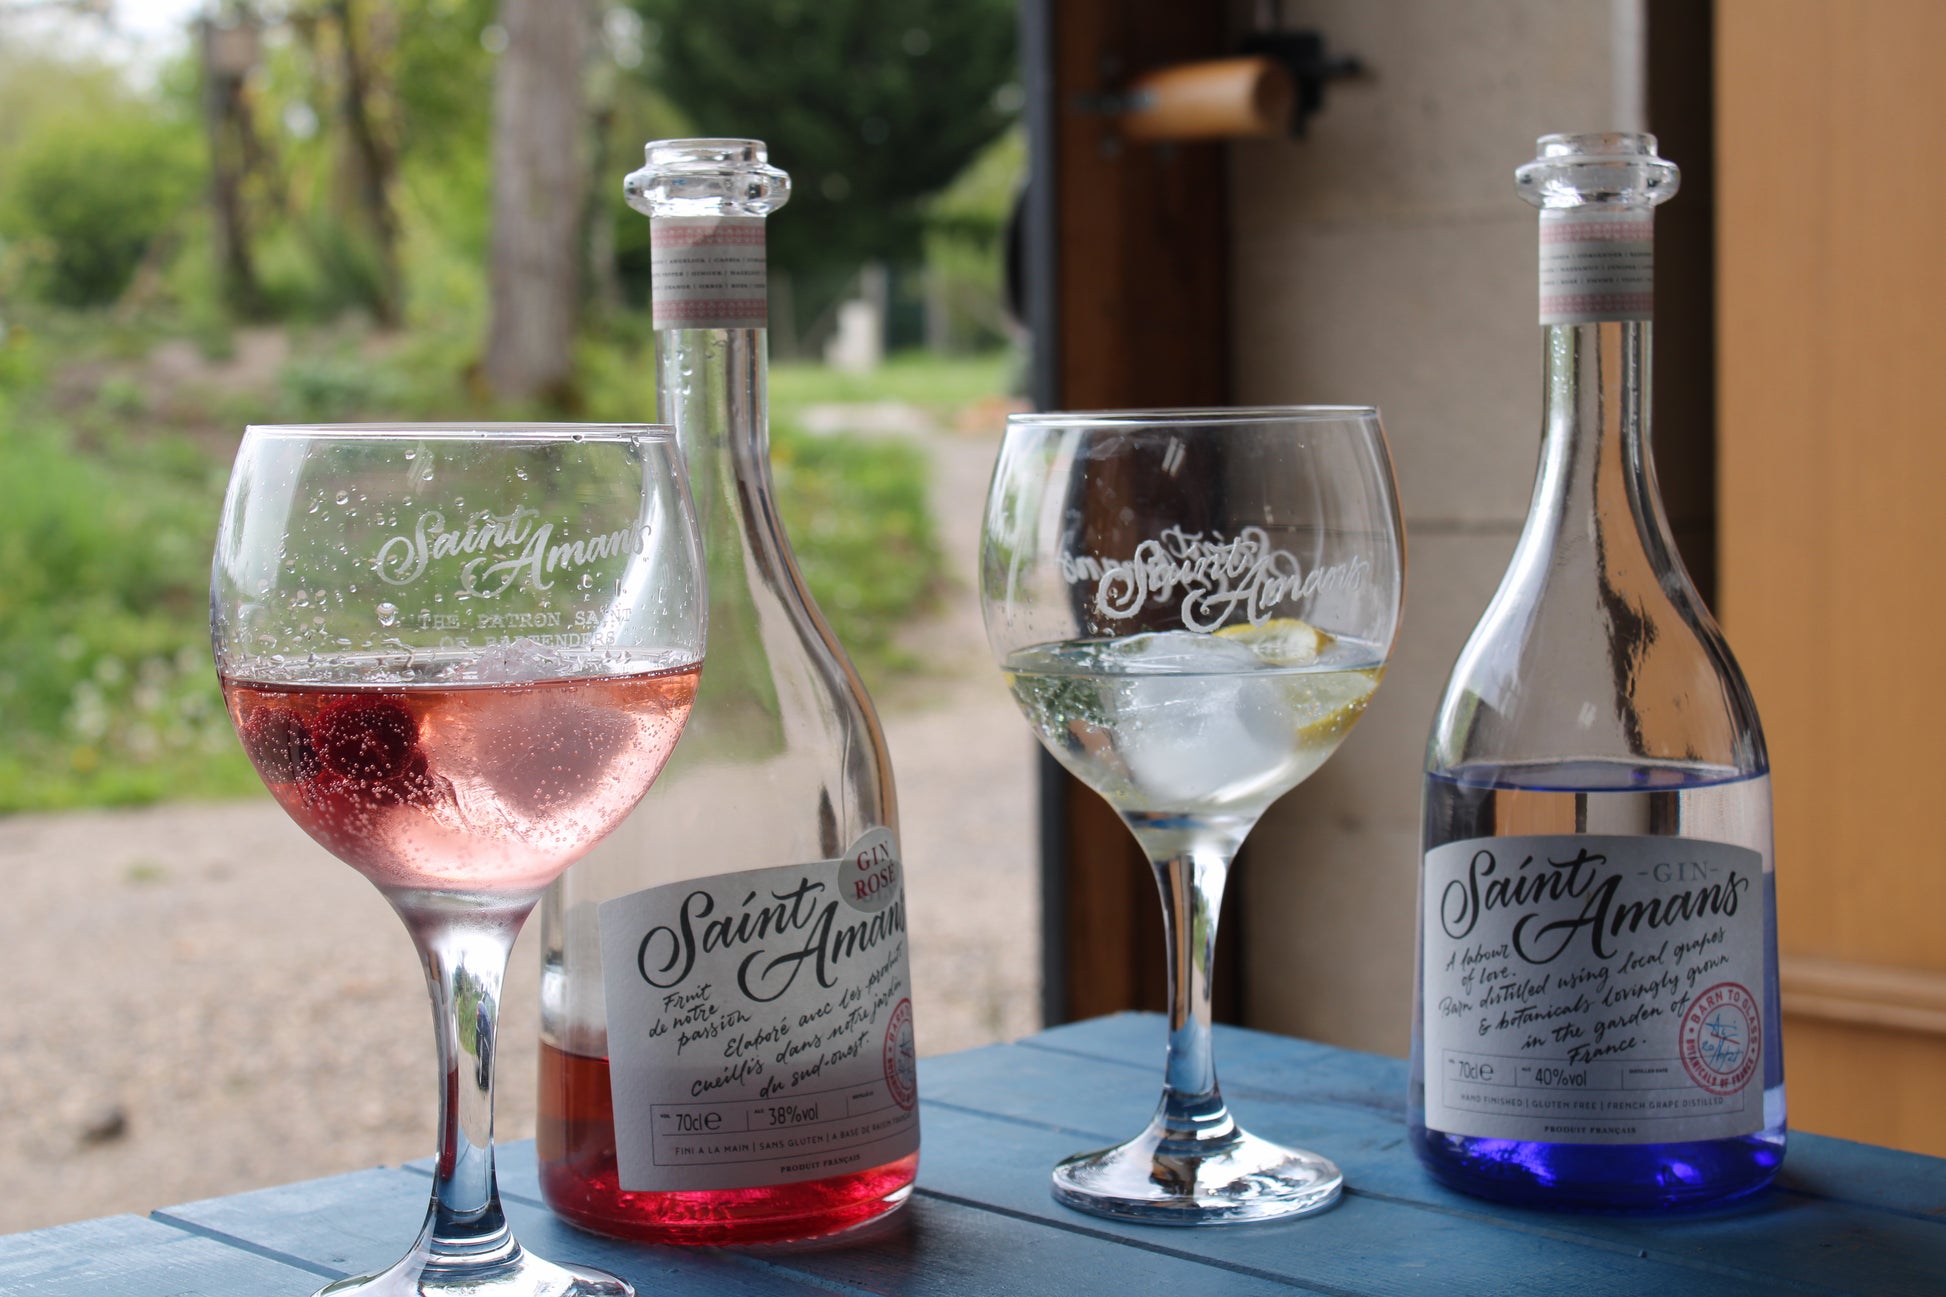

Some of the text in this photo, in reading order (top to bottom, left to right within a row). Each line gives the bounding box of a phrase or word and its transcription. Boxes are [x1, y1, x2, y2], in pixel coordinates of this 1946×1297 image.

[376, 504, 652, 598] Saint Amans
[1099, 536, 1370, 634] Saint Amans
[418, 608, 632, 629] THE PATRON SANT
[484, 631, 615, 649] BATENDERS
[857, 840, 890, 871] GIN
[1440, 848, 1608, 940] Saint
[637, 877, 826, 989] Saint
[1511, 870, 1749, 965] Amans
[1438, 926, 1726, 1018] Barn distilled using local grapes
[1445, 943, 1511, 972] A labour
[1461, 967, 1517, 996] of love.
[1478, 955, 1730, 1036] & botanicals lovingly grown
[663, 983, 712, 1013] Fruit
[648, 1003, 719, 1037] de notre
[677, 1009, 753, 1056] passion
[723, 1014, 790, 1058] Elaboré
[798, 1002, 834, 1027] avec
[838, 988, 862, 1009] les
[1520, 990, 1691, 1050] in the garden of
[1691, 990, 1724, 1024] BARN
[1727, 989, 1741, 1001] TO
[1741, 998, 1758, 1045] GLASS
[691, 1057, 764, 1097] cueillis
[775, 1034, 823, 1064] dans
[826, 1006, 870, 1040] notre
[1567, 1037, 1647, 1066] France.
[759, 1075, 786, 1099] du
[1535, 1067, 1587, 1087] 40%vol
[1460, 1093, 1724, 1110] HAND FINISHED GLUTEN FREE FRENCH GRAPE DISTILLED
[675, 1146, 695, 1156] FINI
[708, 1144, 720, 1154] LA
[724, 1142, 749, 1152] MAIN
[759, 1139, 785, 1151] SANS
[787, 1135, 824, 1148] GLUTEN
[840, 1128, 859, 1139] BASE
[861, 1125, 870, 1134] DE
[1544, 1125, 1636, 1136] PRODUIT FRANÇAIS
[780, 1153, 860, 1174] PRODUIT FRANÇAIS
